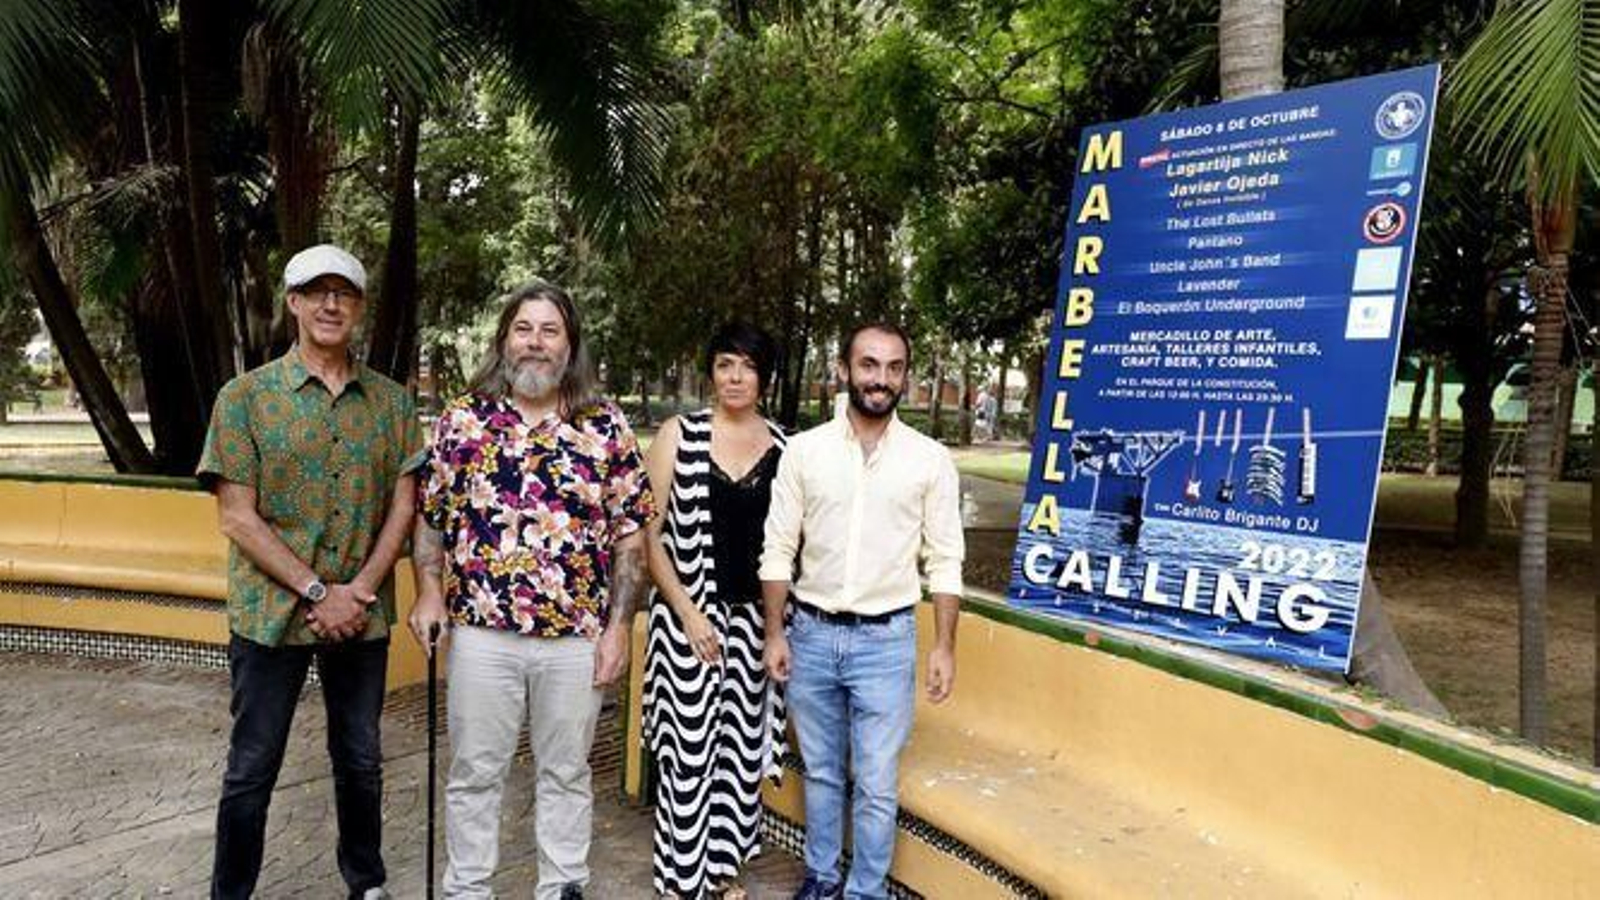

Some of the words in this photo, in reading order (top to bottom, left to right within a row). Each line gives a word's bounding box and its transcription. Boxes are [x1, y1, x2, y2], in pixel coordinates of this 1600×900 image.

[1160, 123, 1213, 142] SÁBADO
[1216, 122, 1224, 133] 8
[1227, 117, 1247, 131] DE
[1250, 105, 1320, 127] OCTUBRE
[1166, 155, 1241, 178] Lagartija
[1248, 148, 1289, 166] Nick
[1169, 180, 1221, 198] Javier
[1227, 172, 1280, 192] Ojeda
[1167, 217, 1190, 230] The
[1194, 214, 1224, 228] Lost
[1226, 210, 1276, 224] Bullets
[1188, 235, 1243, 249] Pantano
[1150, 259, 1186, 273] Uncle
[1243, 254, 1281, 268] Band
[1177, 279, 1240, 293] Lavender
[1117, 301, 1132, 315] El
[1135, 298, 1201, 315] Boquerón
[1205, 297, 1305, 314] Underground
[1028, 131, 1123, 537] MARBELLA
[1129, 331, 1210, 342] MERCADILLO
[1214, 330, 1233, 341] DE
[1235, 329, 1277, 342] ARTE,
[1166, 343, 1230, 356] TALLERES
[1234, 343, 1322, 356] INFANTILES,
[1121, 356, 1160, 368] CRAFT
[1164, 356, 1202, 369] BEER,
[1206, 357, 1215, 367] Y
[1177, 378, 1189, 387] DE
[1172, 502, 1221, 521] Carlito
[1224, 508, 1291, 528] Brigante
[1296, 517, 1320, 533] DJ
[1237, 541, 1338, 580] 2022
[1023, 544, 1330, 634] CALLING
